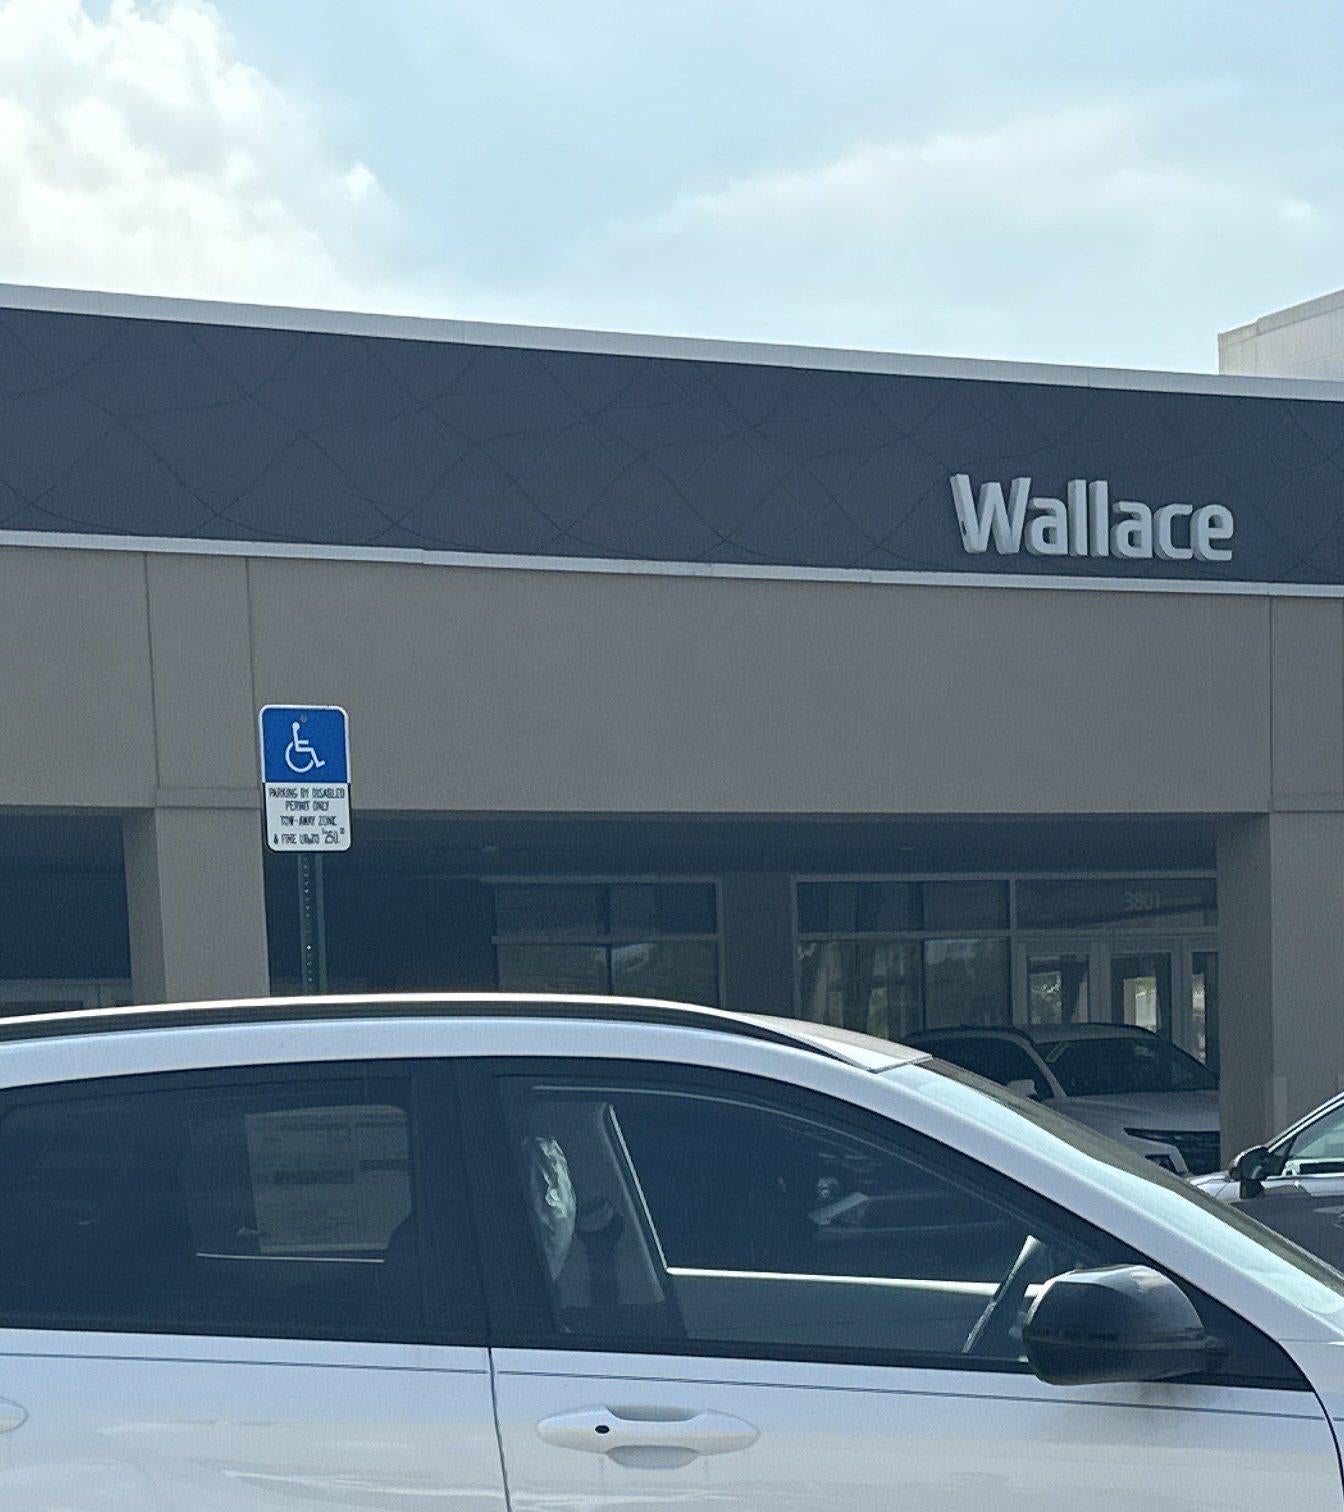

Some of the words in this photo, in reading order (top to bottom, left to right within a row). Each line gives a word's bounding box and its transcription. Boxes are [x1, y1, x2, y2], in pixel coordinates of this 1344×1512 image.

[949, 473, 1234, 561] Wallace
[268, 787, 298, 799] PARKING
[300, 787, 309, 799] BY
[312, 787, 346, 799] DISABLED
[285, 800, 310, 811] PERMIT
[312, 800, 330, 811] ONLY
[280, 815, 316, 826] TOW-AWAY
[318, 815, 337, 826] ZONE
